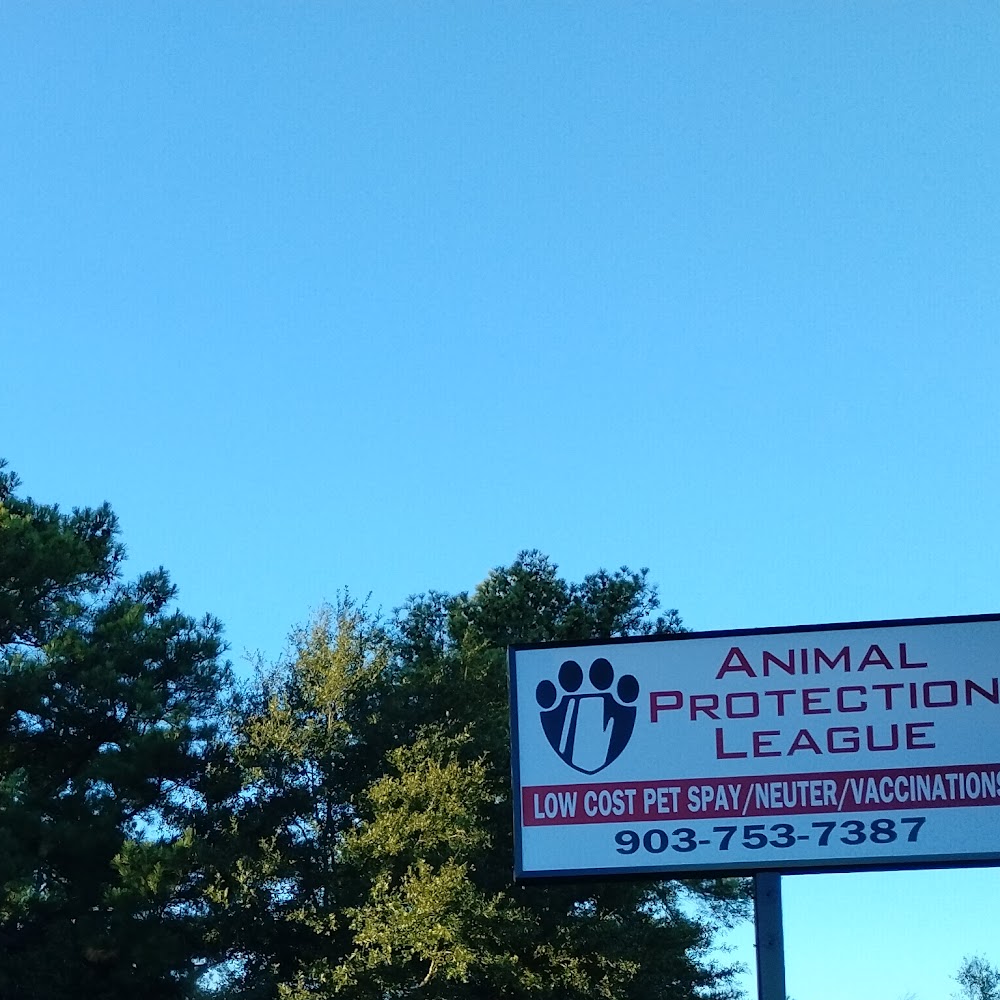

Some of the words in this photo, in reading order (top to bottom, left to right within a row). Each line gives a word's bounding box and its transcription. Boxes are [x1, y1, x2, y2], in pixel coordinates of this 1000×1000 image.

[715, 642, 928, 680] ANIMAL
[650, 677, 999, 723] PROTECTION
[715, 721, 936, 760] LEAGUE
[533, 792, 577, 820] LOW
[584, 787, 635, 817] COST
[643, 786, 681, 815] PET
[688, 770, 1000, 816] SPAY/NEUTER/VACCINATION
[614, 816, 927, 855] 903-753-7387
